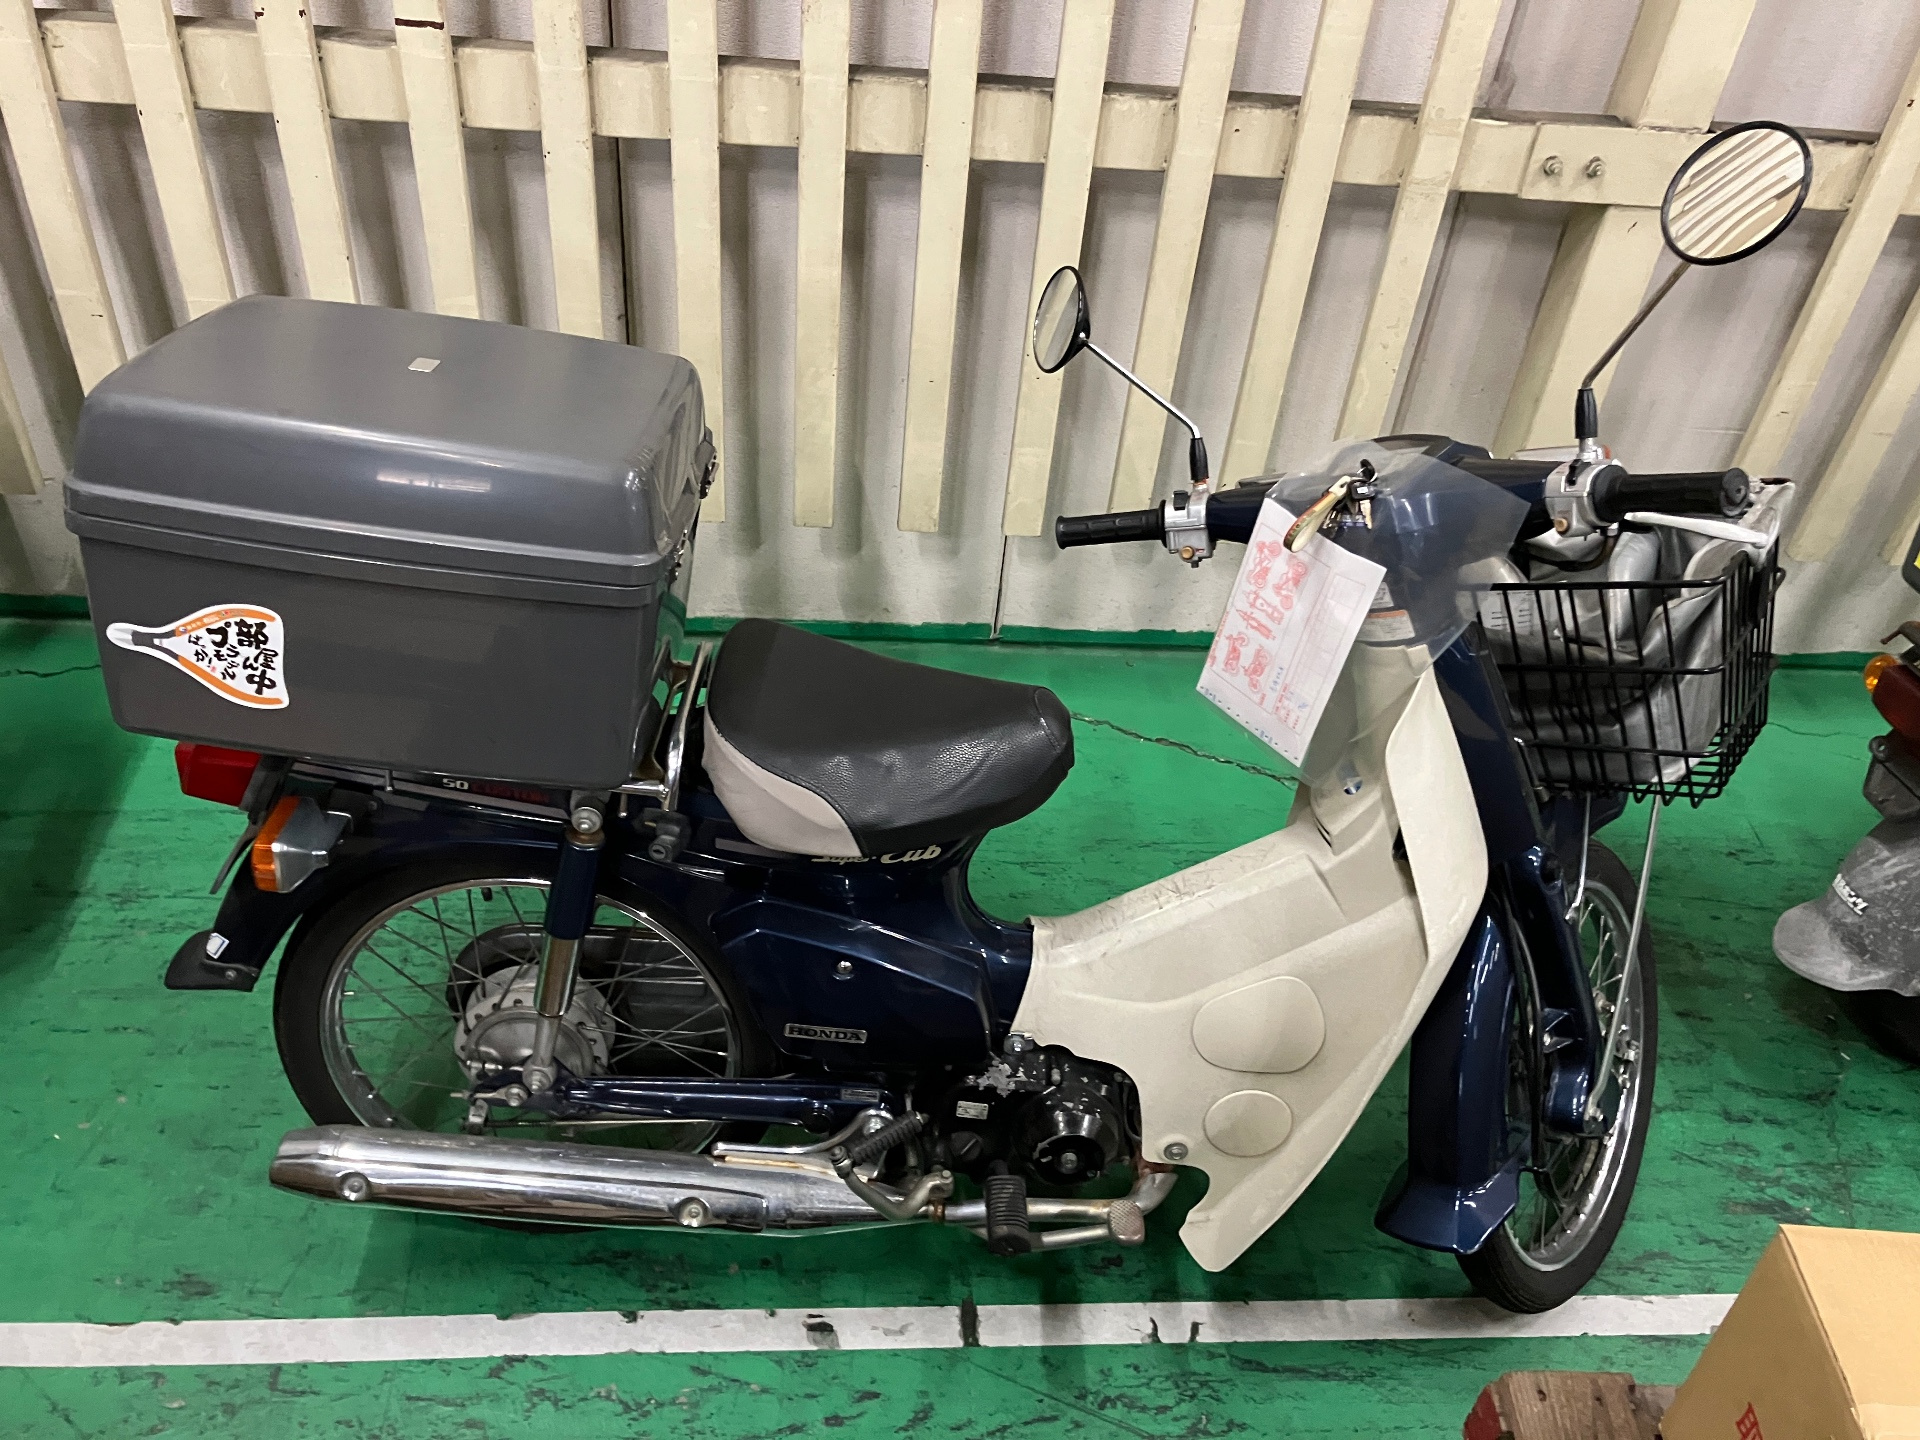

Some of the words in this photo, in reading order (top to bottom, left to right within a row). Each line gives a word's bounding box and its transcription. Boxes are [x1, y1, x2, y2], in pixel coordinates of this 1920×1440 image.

[442, 778, 469, 790] 50
[880, 844, 941, 864] Cub
[787, 1026, 863, 1041] HONDA
